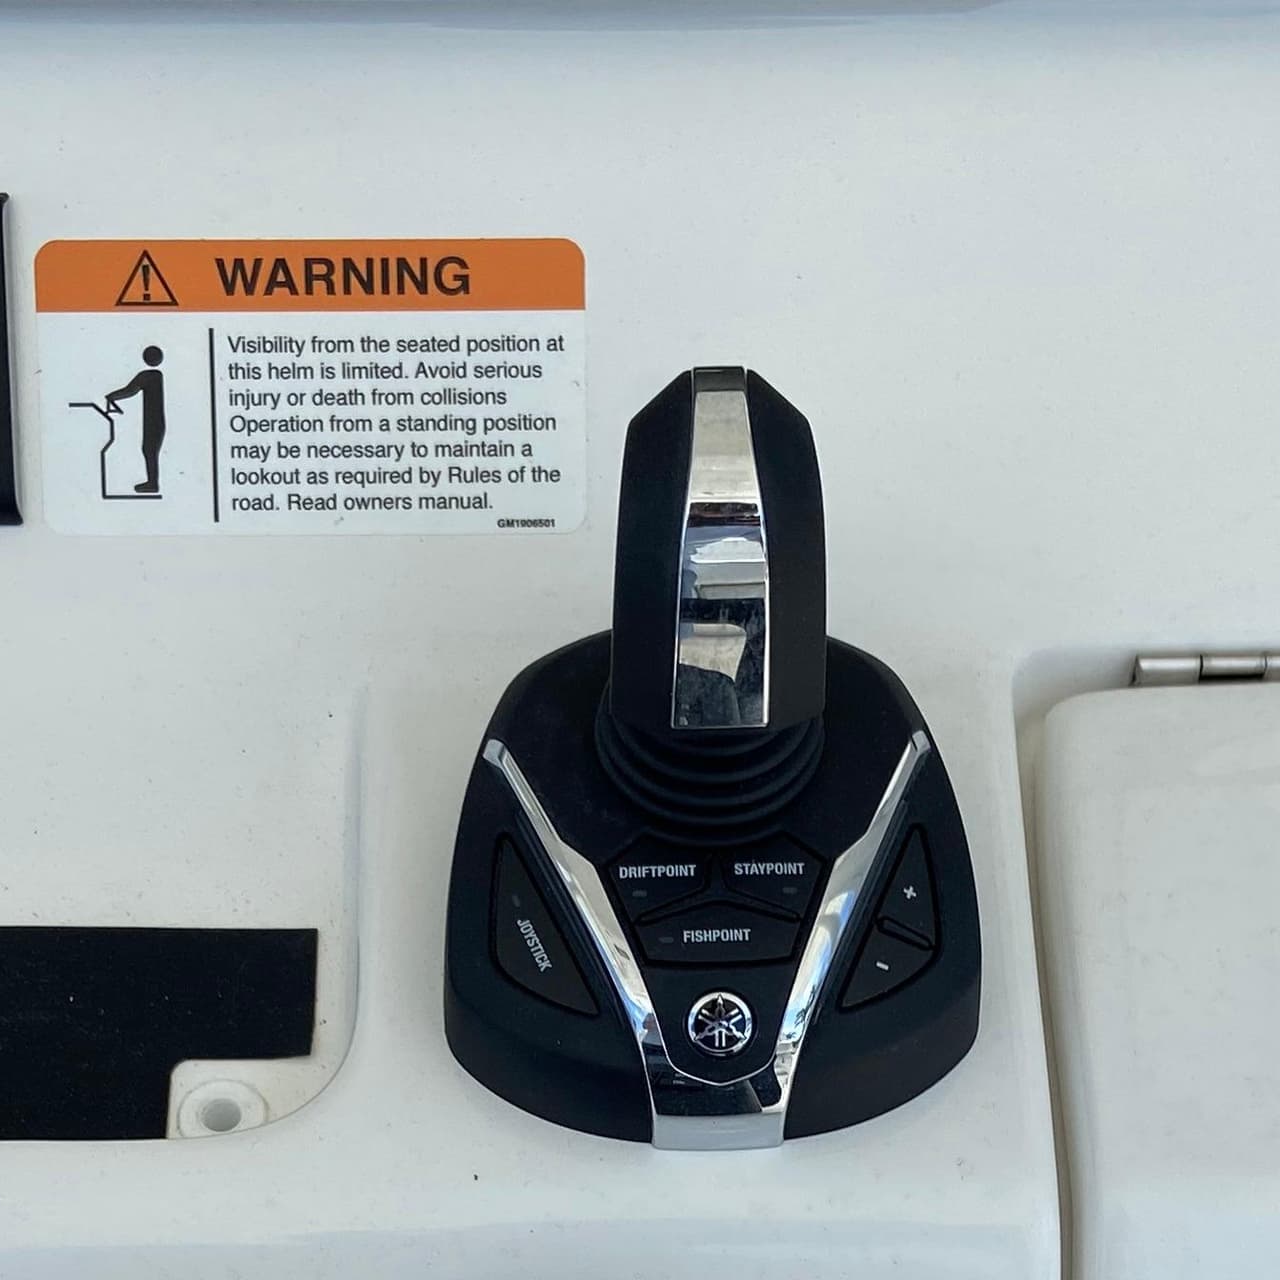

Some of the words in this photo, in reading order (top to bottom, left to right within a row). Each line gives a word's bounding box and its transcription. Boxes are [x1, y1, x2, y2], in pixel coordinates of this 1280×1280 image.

[216, 256, 470, 296] WARNING
[227, 335, 306, 357] Visibility
[311, 336, 354, 353] from
[360, 336, 390, 353] the
[396, 335, 460, 353] seated
[466, 335, 540, 356] position
[546, 335, 564, 352] at
[228, 363, 262, 380] this
[268, 362, 314, 380] helm
[321, 363, 336, 380] is
[342, 362, 409, 379] limited.
[414, 361, 467, 378] Avoid
[473, 361, 542, 378] serious
[229, 389, 281, 411] injury
[287, 392, 306, 406] or
[312, 389, 365, 406] death
[371, 389, 414, 405] from
[420, 388, 507, 405] collisions
[230, 415, 323, 436] Operation
[329, 415, 372, 432] from
[379, 418, 390, 432] a
[396, 414, 476, 436] standing
[483, 414, 556, 435] position
[231, 445, 270, 463] may
[277, 441, 300, 458] be
[307, 444, 404, 462] necessary
[411, 442, 428, 458] to
[435, 440, 514, 457] maintain
[521, 443, 533, 457] a
[231, 468, 301, 484] lookout
[306, 471, 329, 484] as
[335, 467, 412, 488] required
[420, 466, 441, 488] by
[448, 466, 502, 483] Rules
[508, 466, 526, 483] of
[531, 466, 561, 483] the
[232, 494, 280, 511] road.
[288, 493, 337, 511] Read
[343, 496, 412, 510] owners
[419, 492, 493, 509] manual.
[497, 518, 555, 528] GM1906501
[619, 864, 696, 880] DRIFTPOINT
[734, 862, 805, 876] STAYPOINT
[517, 920, 552, 972] JOYSTICK
[683, 928, 751, 942] FISHPOINT
